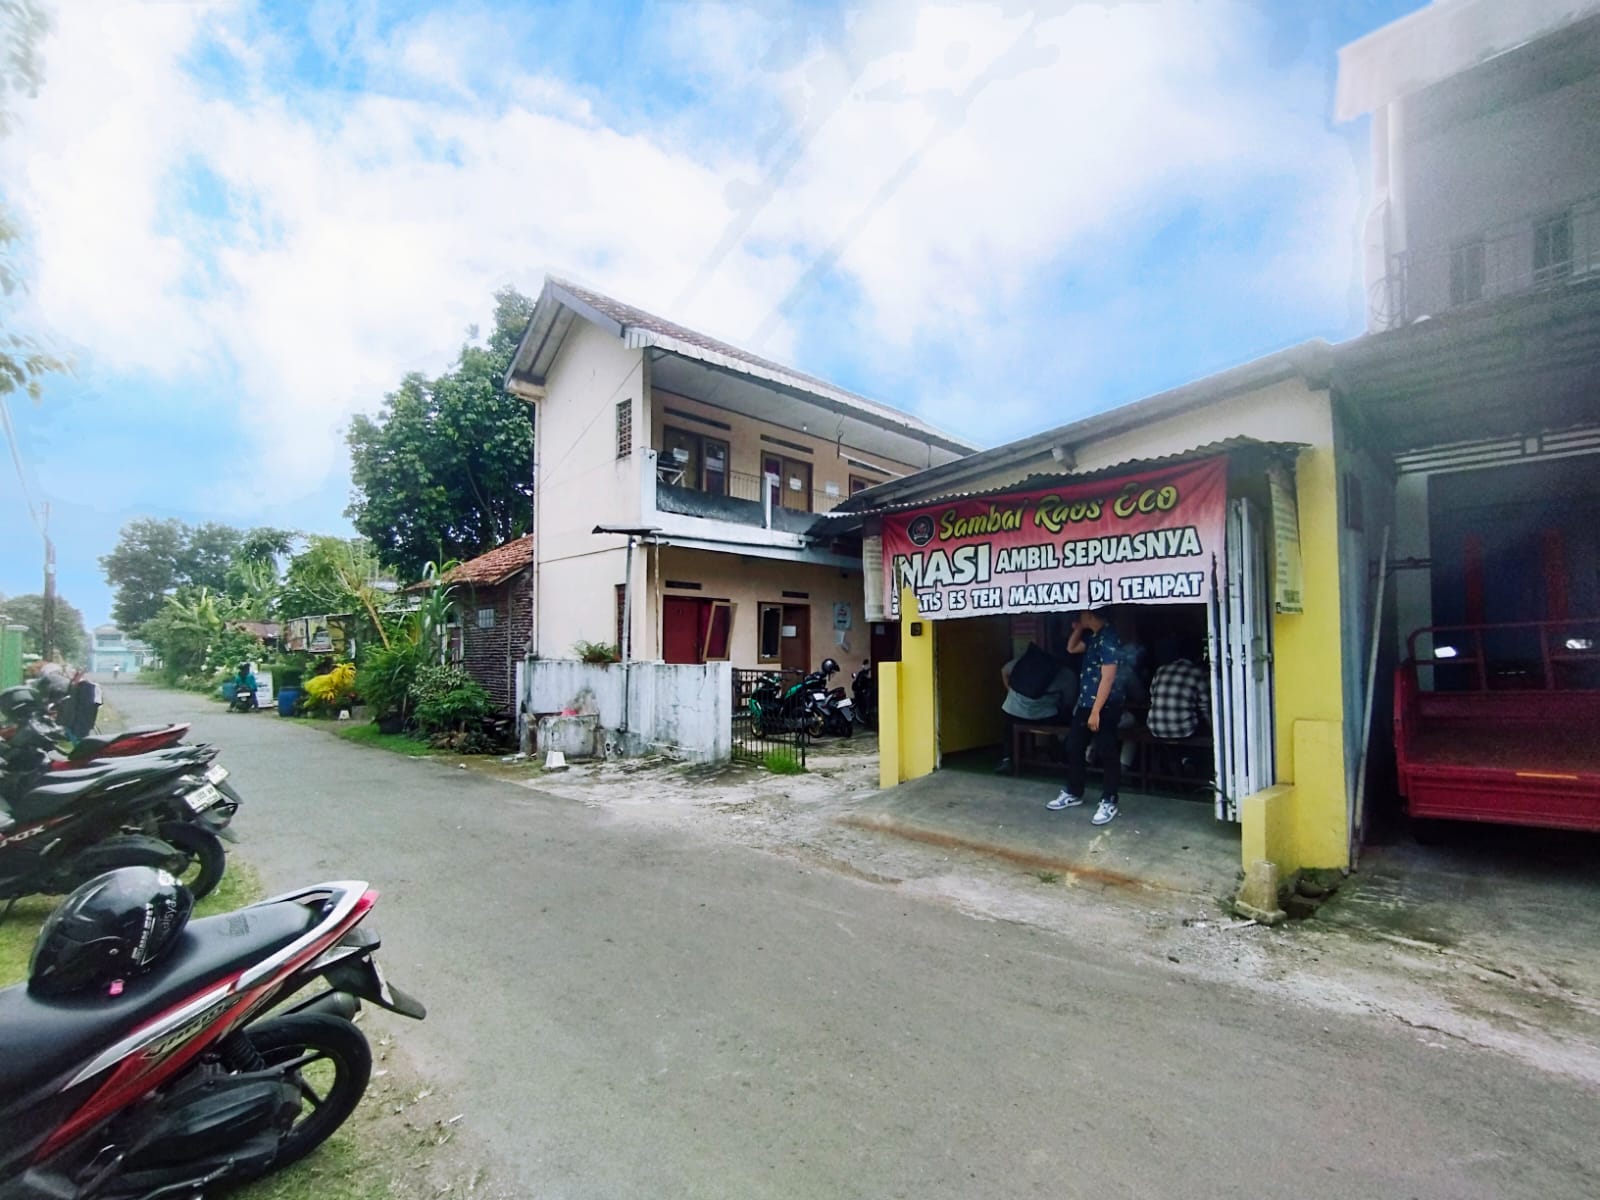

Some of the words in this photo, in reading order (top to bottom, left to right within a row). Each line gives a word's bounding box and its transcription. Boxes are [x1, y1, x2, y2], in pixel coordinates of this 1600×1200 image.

[1033, 495, 1104, 534] Raos
[1113, 482, 1178, 518] Eco
[892, 543, 991, 590] NASI
[995, 543, 1059, 574] AMBIL
[1062, 526, 1203, 567] SEPUASNYA
[948, 591, 966, 610] ES
[971, 588, 1001, 609] TEH
[1009, 581, 1080, 606] MAKAN
[1089, 579, 1111, 601] DI
[1119, 572, 1203, 601] TEMPAT
